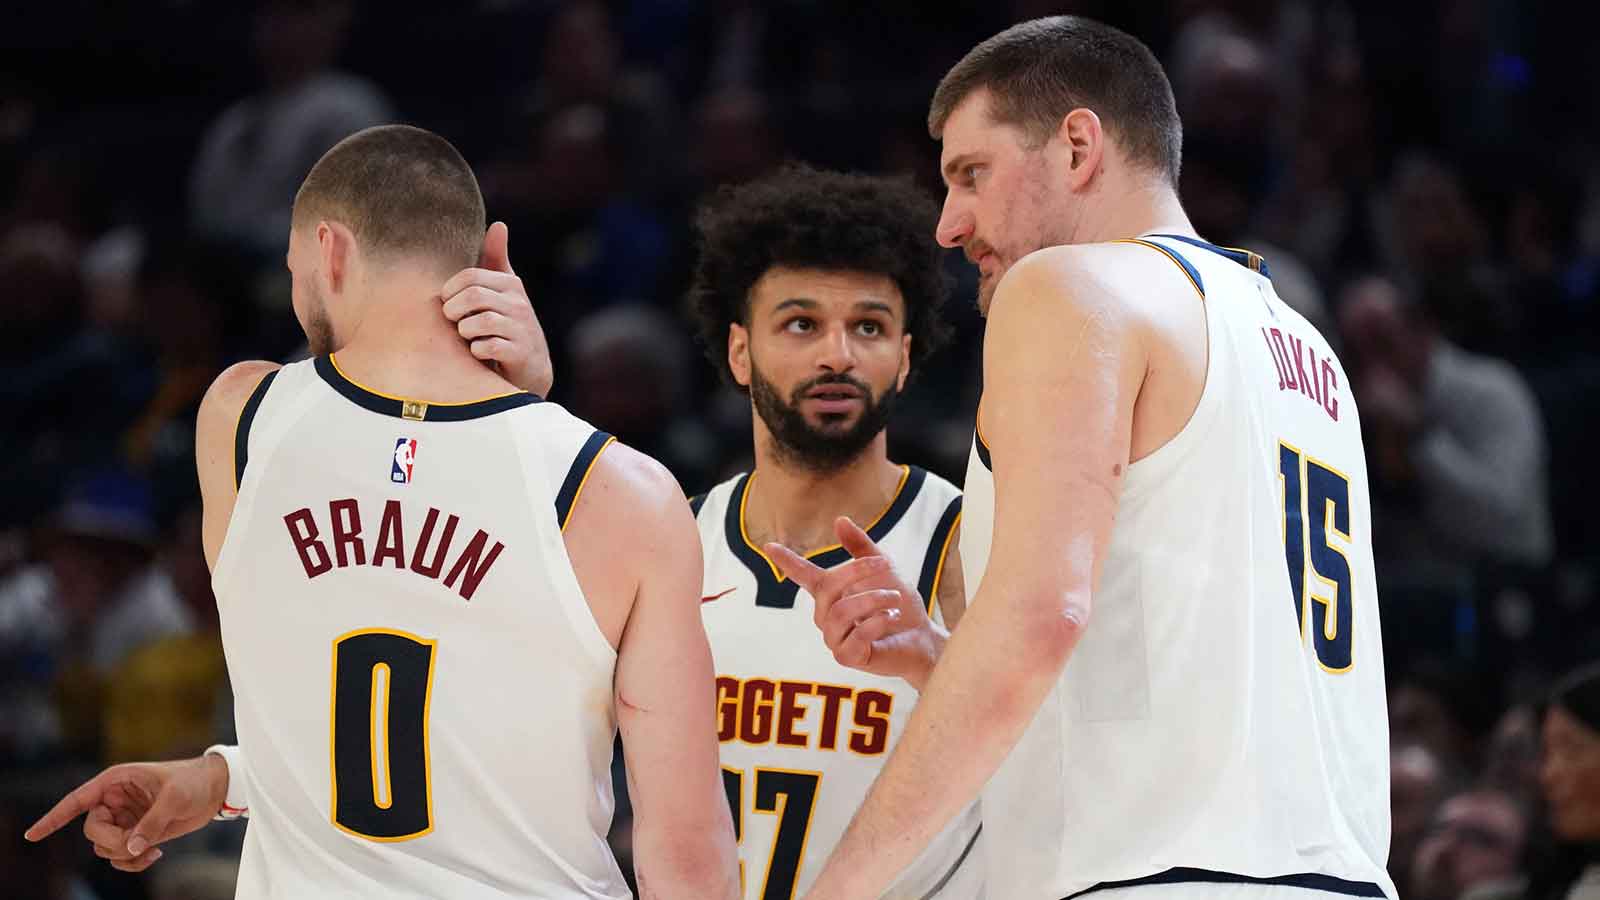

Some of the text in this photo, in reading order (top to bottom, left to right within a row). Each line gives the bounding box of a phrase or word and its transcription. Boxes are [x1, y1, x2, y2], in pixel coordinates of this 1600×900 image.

[283, 498, 505, 601] BRAUN
[1278, 438, 1354, 674] 15
[329, 627, 438, 843] 0
[714, 674, 895, 757] GGETS
